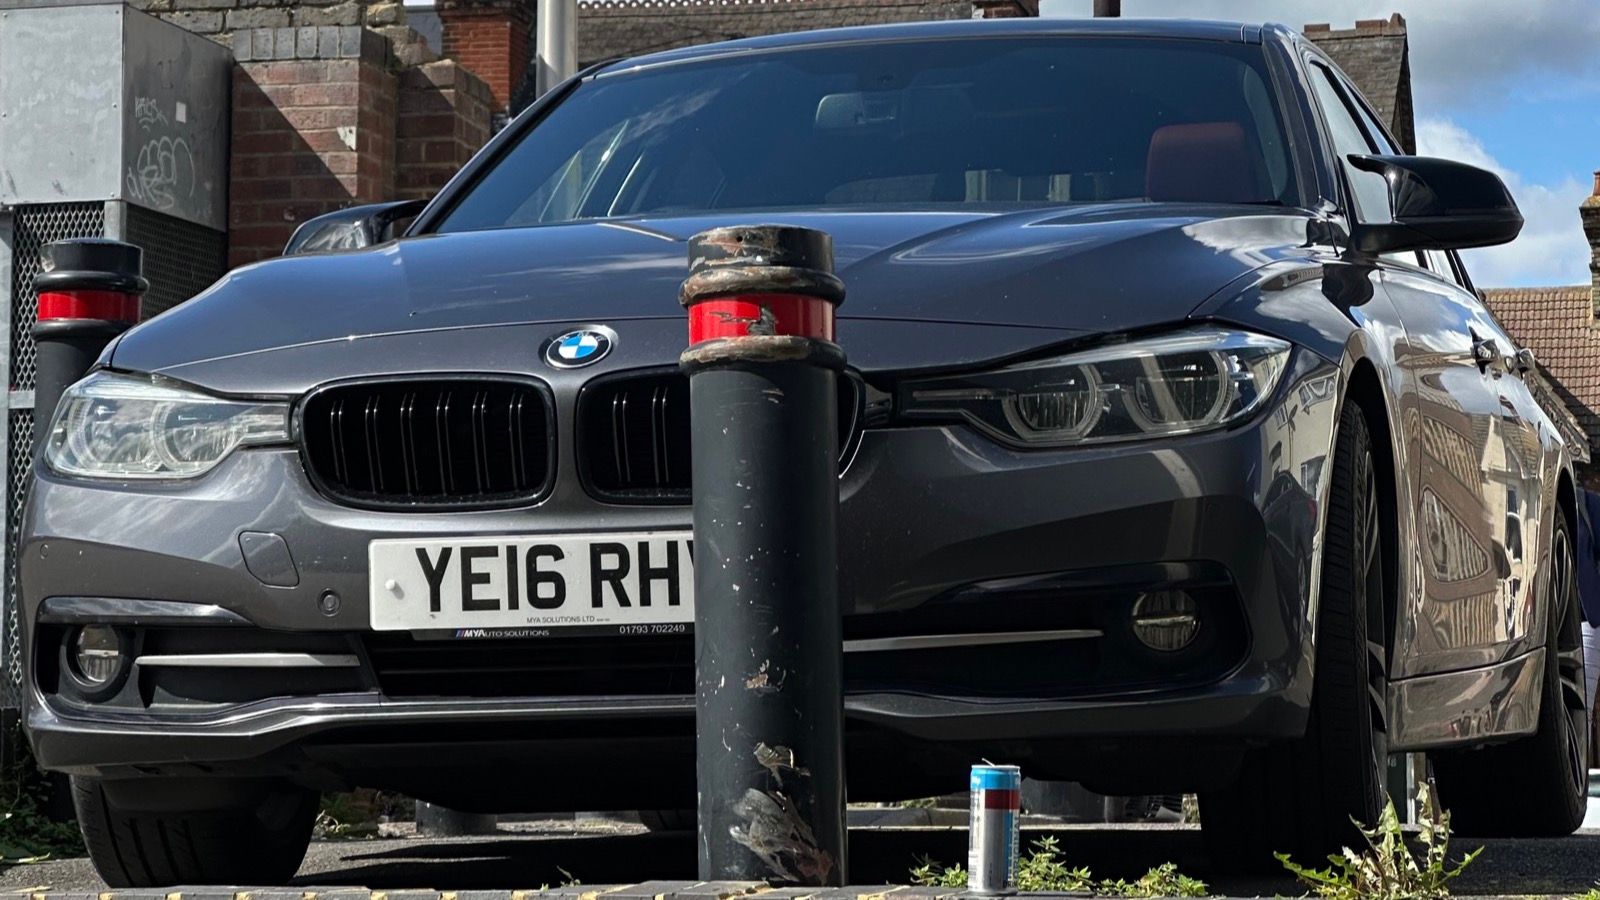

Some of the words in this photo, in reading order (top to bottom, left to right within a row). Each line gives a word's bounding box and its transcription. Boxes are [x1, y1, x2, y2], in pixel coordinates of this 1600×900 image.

[415, 544, 566, 612] YE16
[589, 540, 694, 608] RH
[504, 629, 550, 637] SOLUTIONS
[619, 625, 649, 634] 01793
[651, 624, 686, 633] 702249
